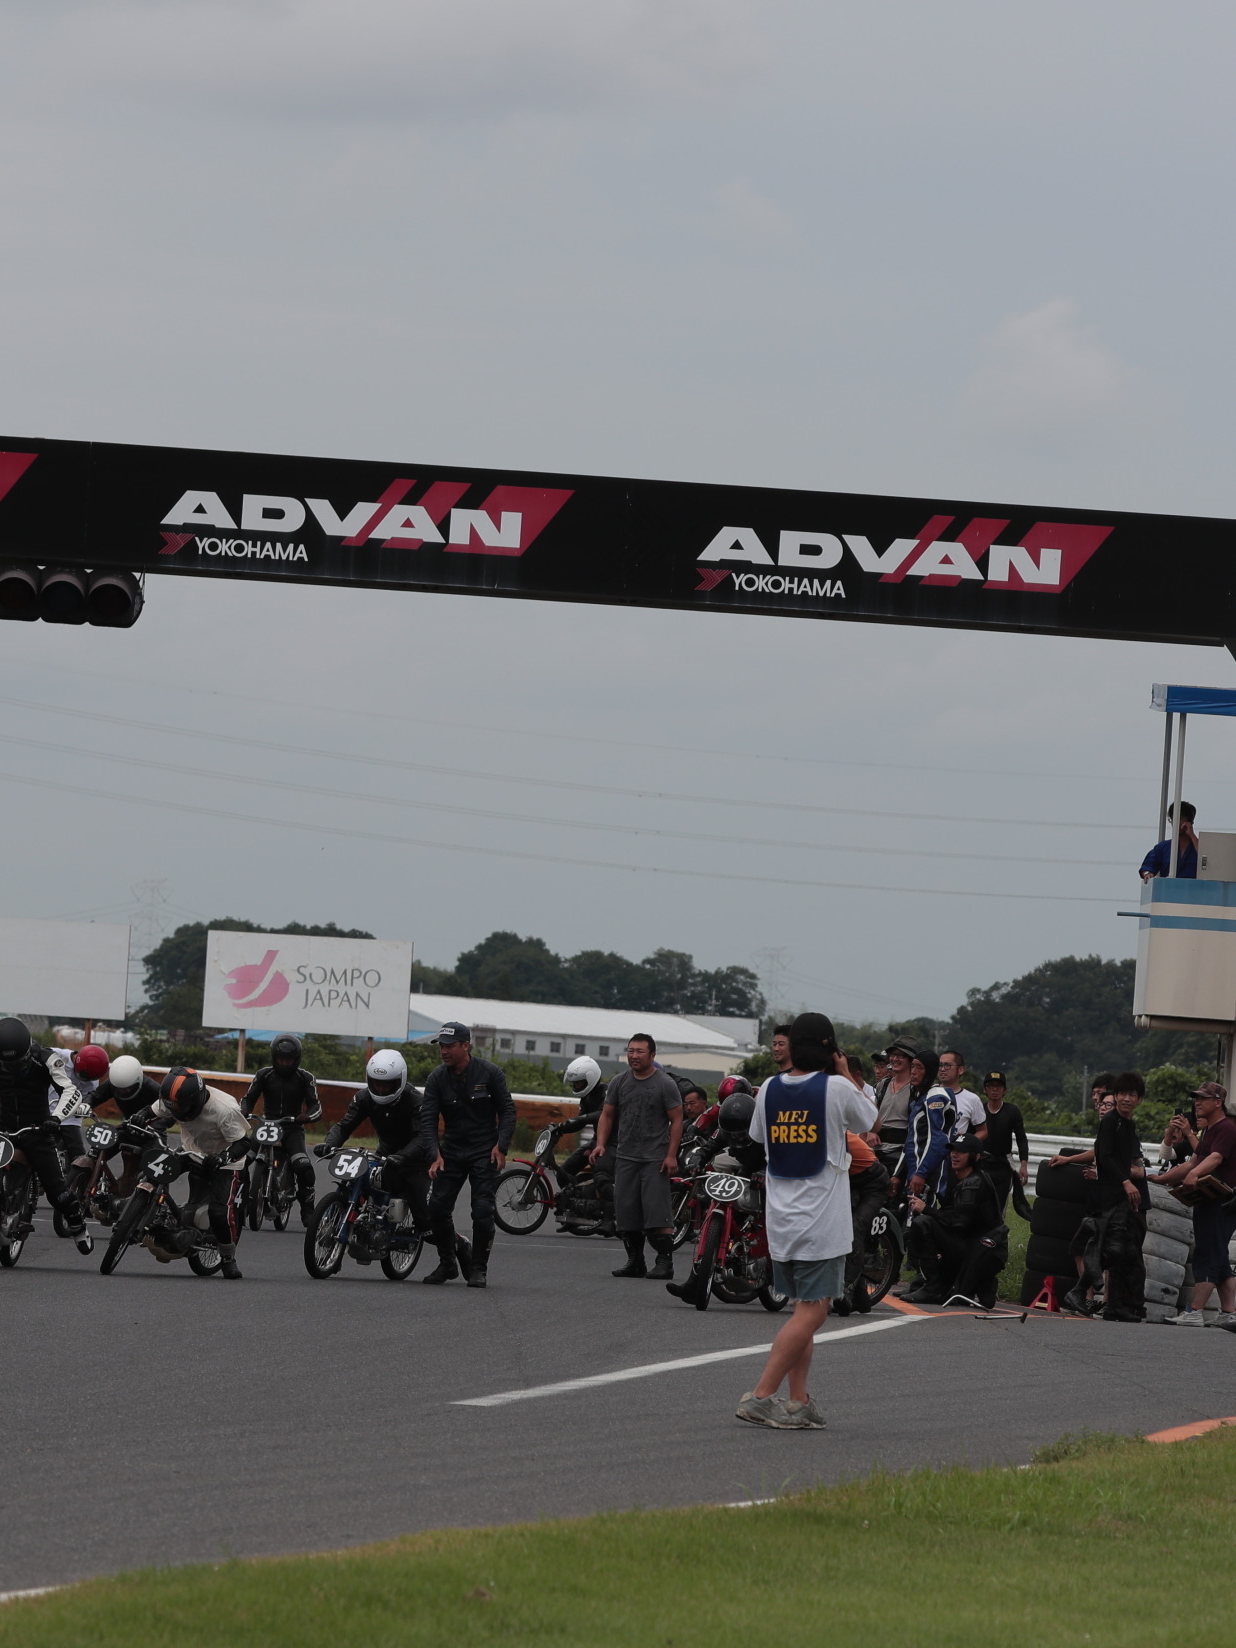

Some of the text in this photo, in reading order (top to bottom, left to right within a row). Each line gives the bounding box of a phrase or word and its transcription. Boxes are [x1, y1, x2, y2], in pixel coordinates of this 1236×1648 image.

[160, 490, 523, 549] ADVAN
[194, 536, 309, 562] YOKOHAMA
[696, 526, 1062, 586] ADVAN
[731, 572, 846, 598] YOKOHAMA
[296, 965, 382, 988] SOMPO
[301, 988, 371, 1010] JAPAN
[61, 1089, 81, 1116] GREED
[776, 1110, 809, 1123] MFJ
[91, 1127, 112, 1145] 50
[256, 1126, 279, 1142] 63
[771, 1124, 818, 1144] PRESS
[147, 1153, 169, 1178] 4
[334, 1154, 364, 1178] 54
[709, 1177, 738, 1197] 49
[871, 1215, 887, 1236] 83
